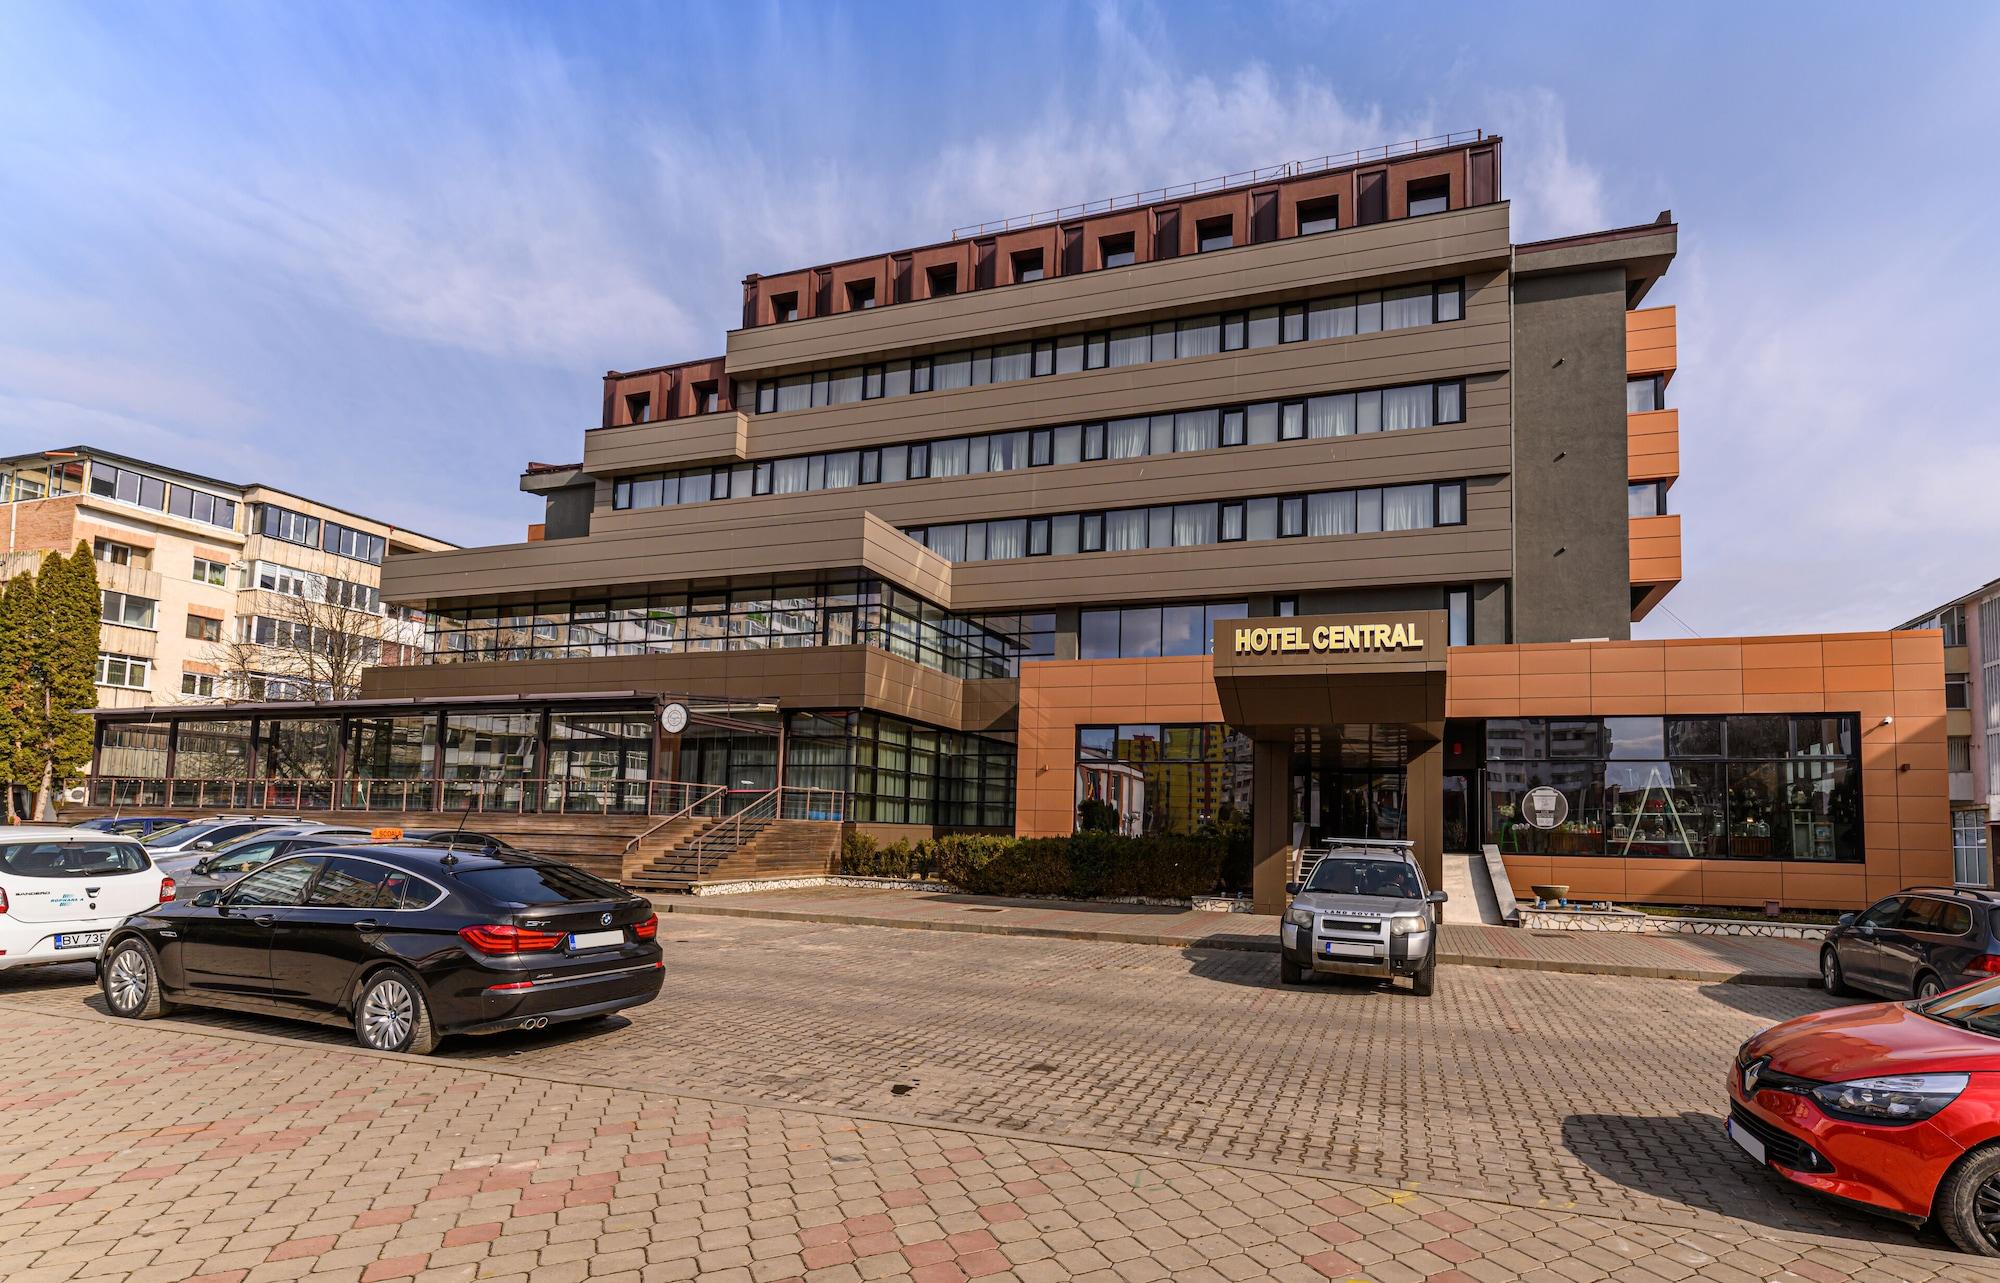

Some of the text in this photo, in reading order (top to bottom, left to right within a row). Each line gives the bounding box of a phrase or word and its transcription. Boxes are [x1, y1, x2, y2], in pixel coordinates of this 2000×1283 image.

[1235, 622, 1424, 653] HOTEL CENTRAL
[62, 935, 80, 946] BV
